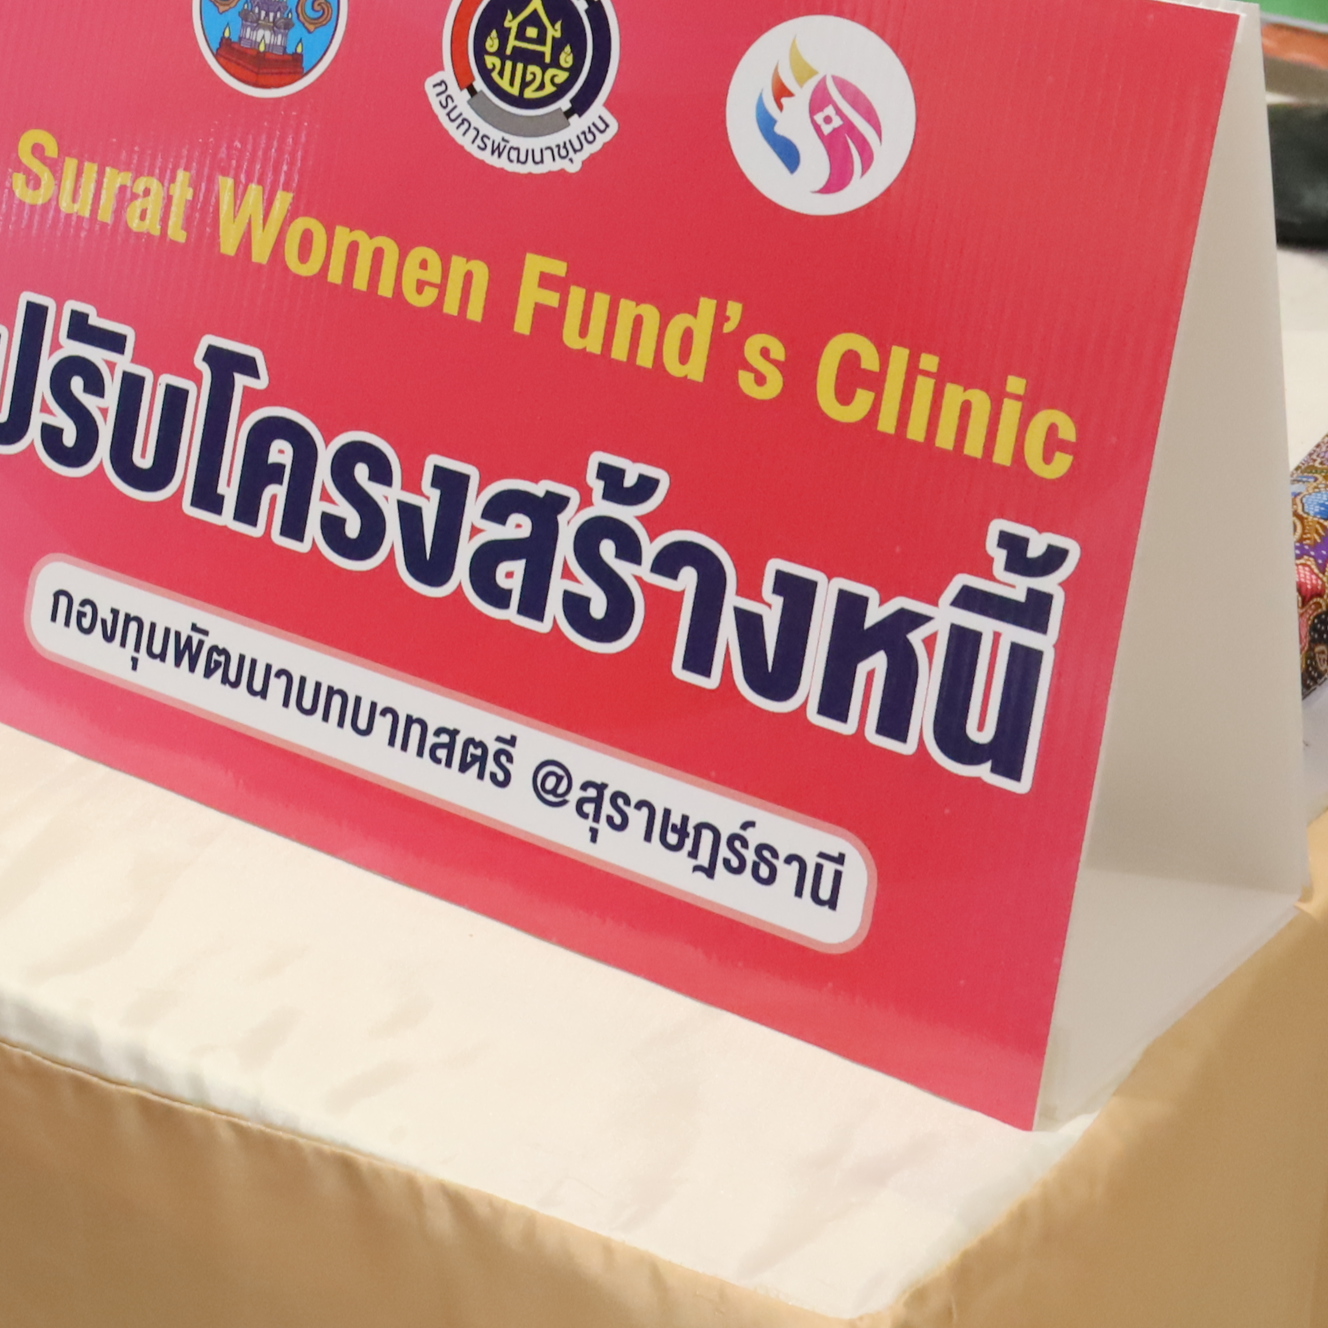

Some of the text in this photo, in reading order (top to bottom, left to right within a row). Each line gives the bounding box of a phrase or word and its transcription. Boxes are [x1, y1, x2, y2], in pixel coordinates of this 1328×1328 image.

[431, 77, 611, 165] กรมการพัฒนาชุมชน
[11, 128, 1078, 480] Surat Women Fund's Clinic
[49, 584, 848, 913] กองทุนพัฒนาบทบาทสตรี @สุราษฎร์ธานี
